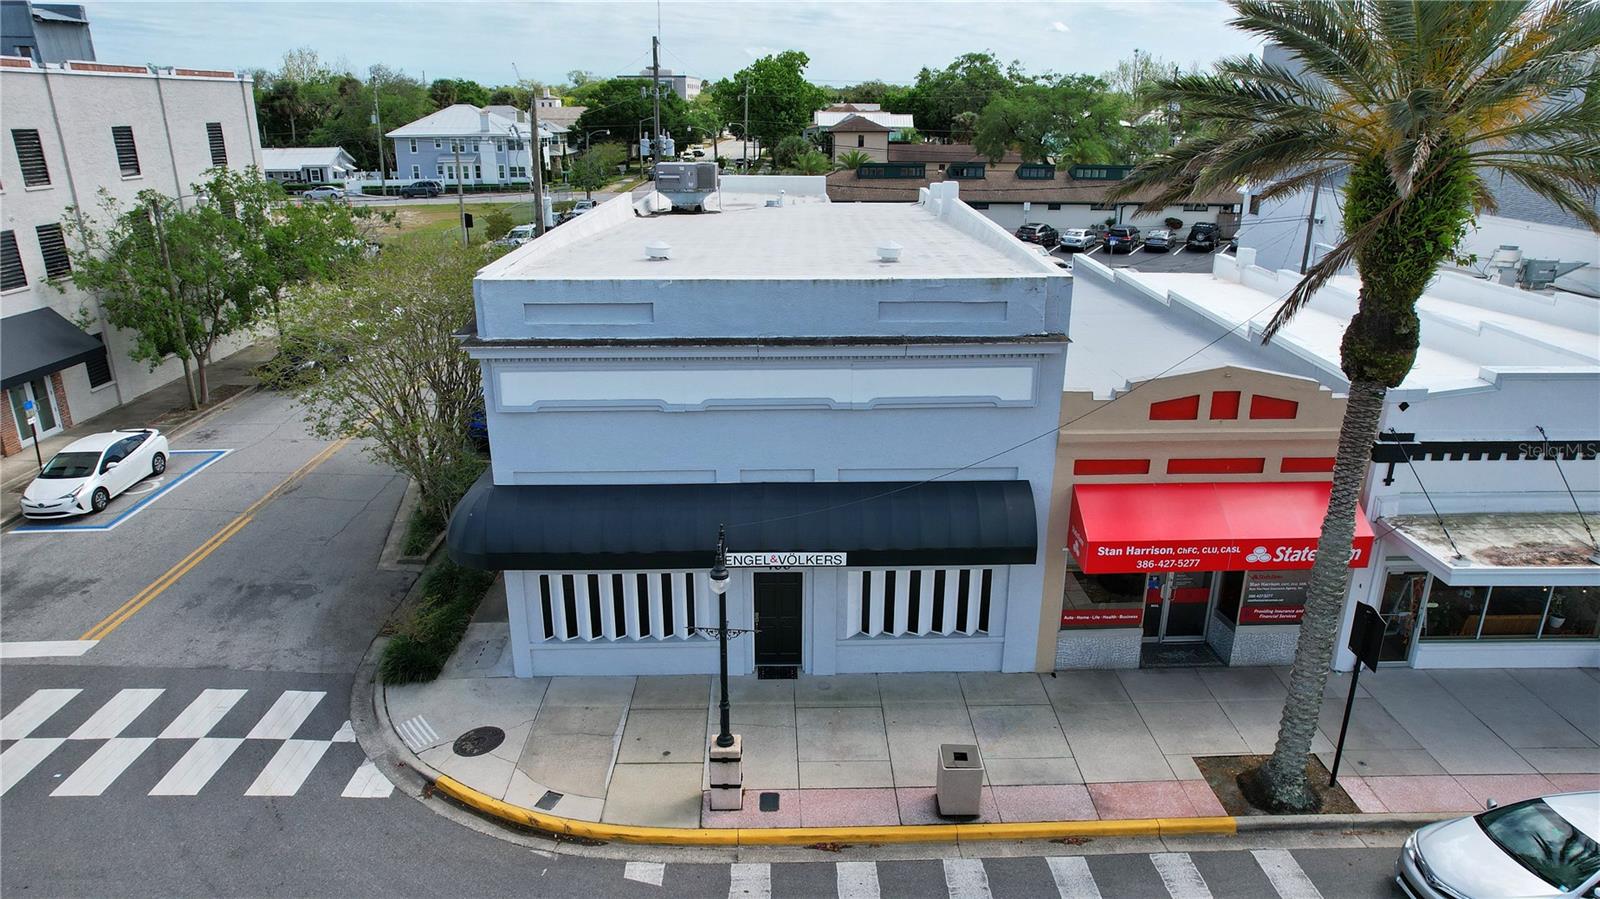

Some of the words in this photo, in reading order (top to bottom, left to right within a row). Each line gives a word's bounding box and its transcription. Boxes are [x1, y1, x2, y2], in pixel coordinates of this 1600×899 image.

[1097, 546, 1123, 556] Stan
[1126, 546, 1176, 556] Harrison,
[1177, 546, 1200, 555] ChFC,
[1201, 546, 1220, 555] CLU,
[1220, 546, 1241, 554] CASL
[725, 553, 843, 566] ENGEL&VÖLKERS
[1136, 558, 1201, 569] 386-427-5277
